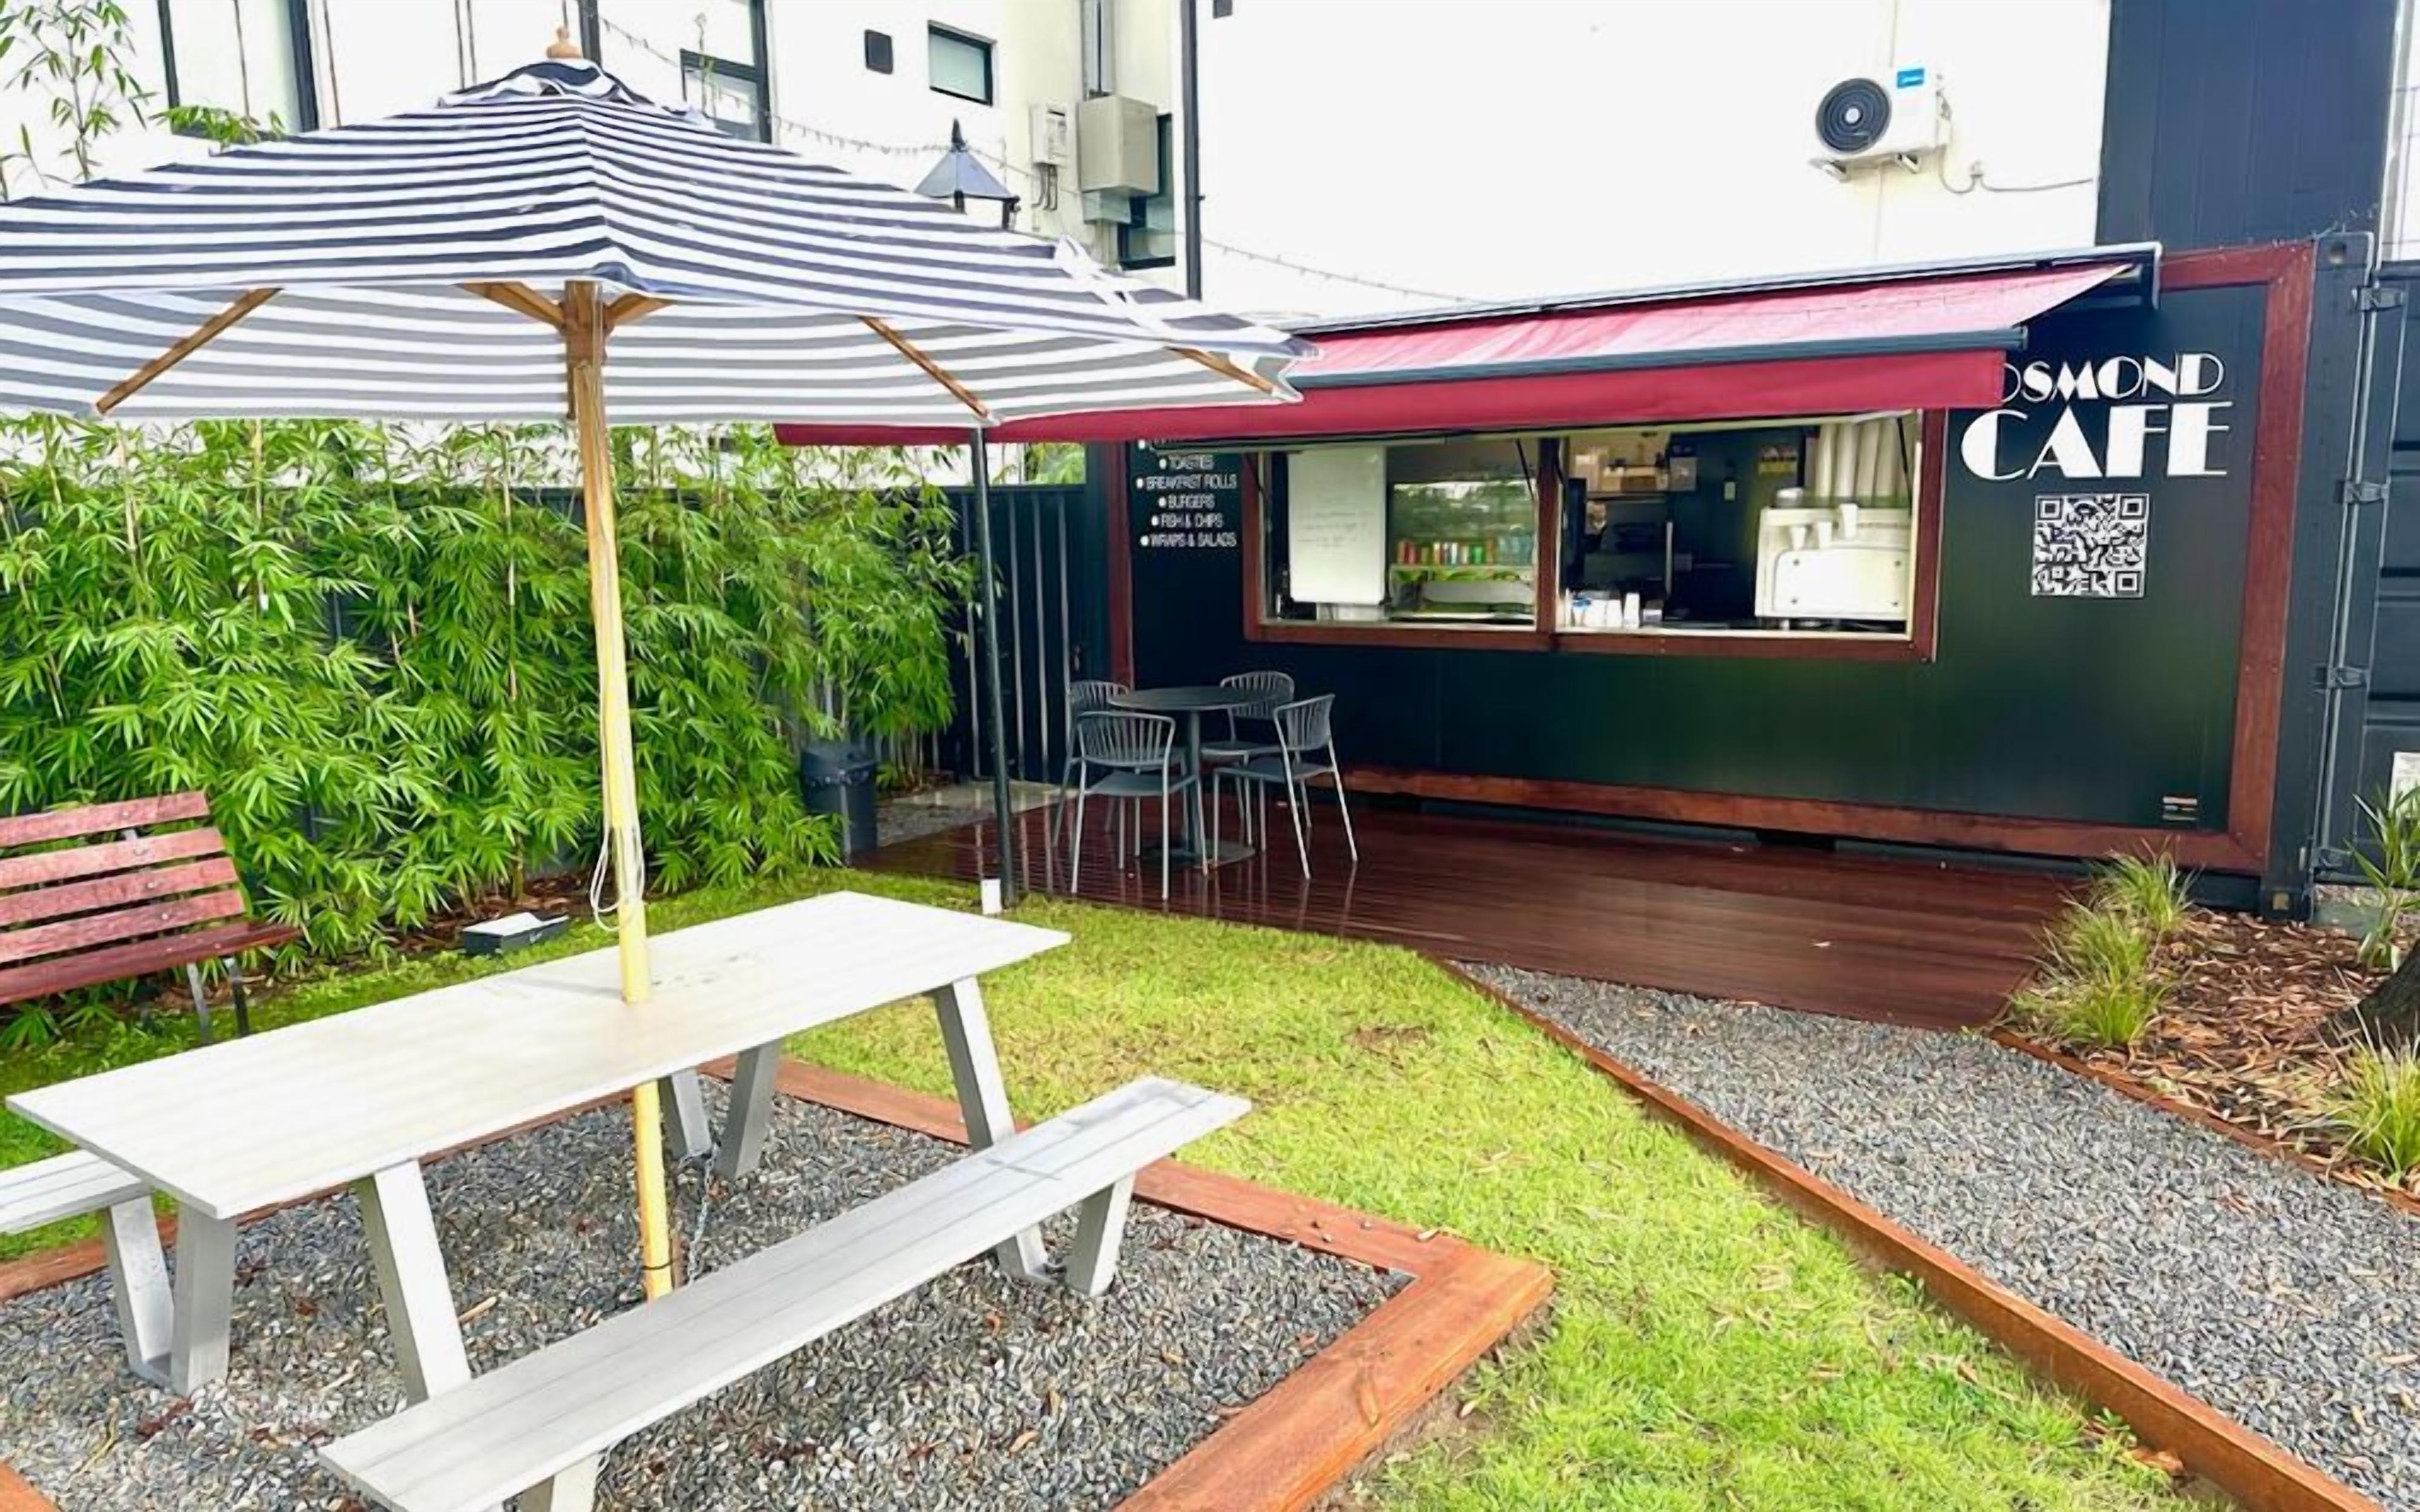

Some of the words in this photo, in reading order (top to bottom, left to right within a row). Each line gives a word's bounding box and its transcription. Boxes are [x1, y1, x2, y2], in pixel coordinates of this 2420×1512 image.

[1961, 401, 2234, 480] CAFE
[1146, 474, 1201, 490] BREAKFAST
[1204, 474, 1237, 489] ROLLS
[1168, 494, 1215, 509] BURGERS
[1160, 513, 1181, 527] FISH
[1184, 513, 1192, 528] &
[1194, 513, 1223, 527] CHIPS
[1150, 533, 1185, 547] WRAPS
[1188, 533, 1195, 547] &
[1197, 532, 1237, 547] SALADS
